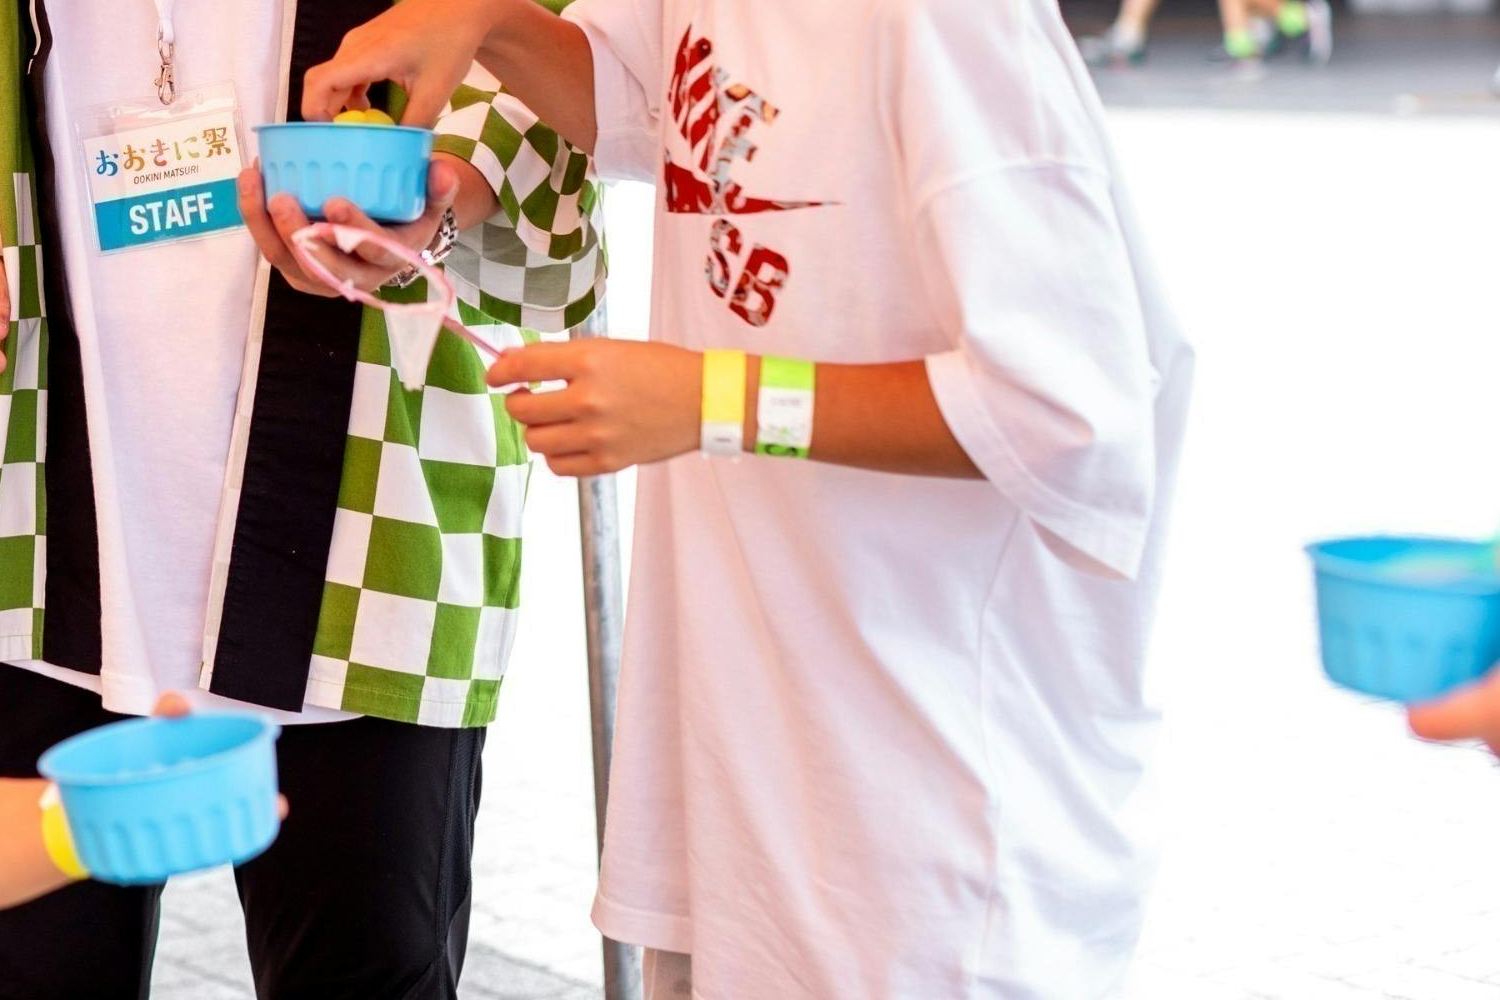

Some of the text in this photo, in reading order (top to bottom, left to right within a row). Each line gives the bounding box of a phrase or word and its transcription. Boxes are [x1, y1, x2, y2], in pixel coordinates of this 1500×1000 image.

[96, 126, 232, 177] おおきに祭
[133, 164, 199, 185] OOKINI MATSURI
[129, 191, 214, 235] STAFF
